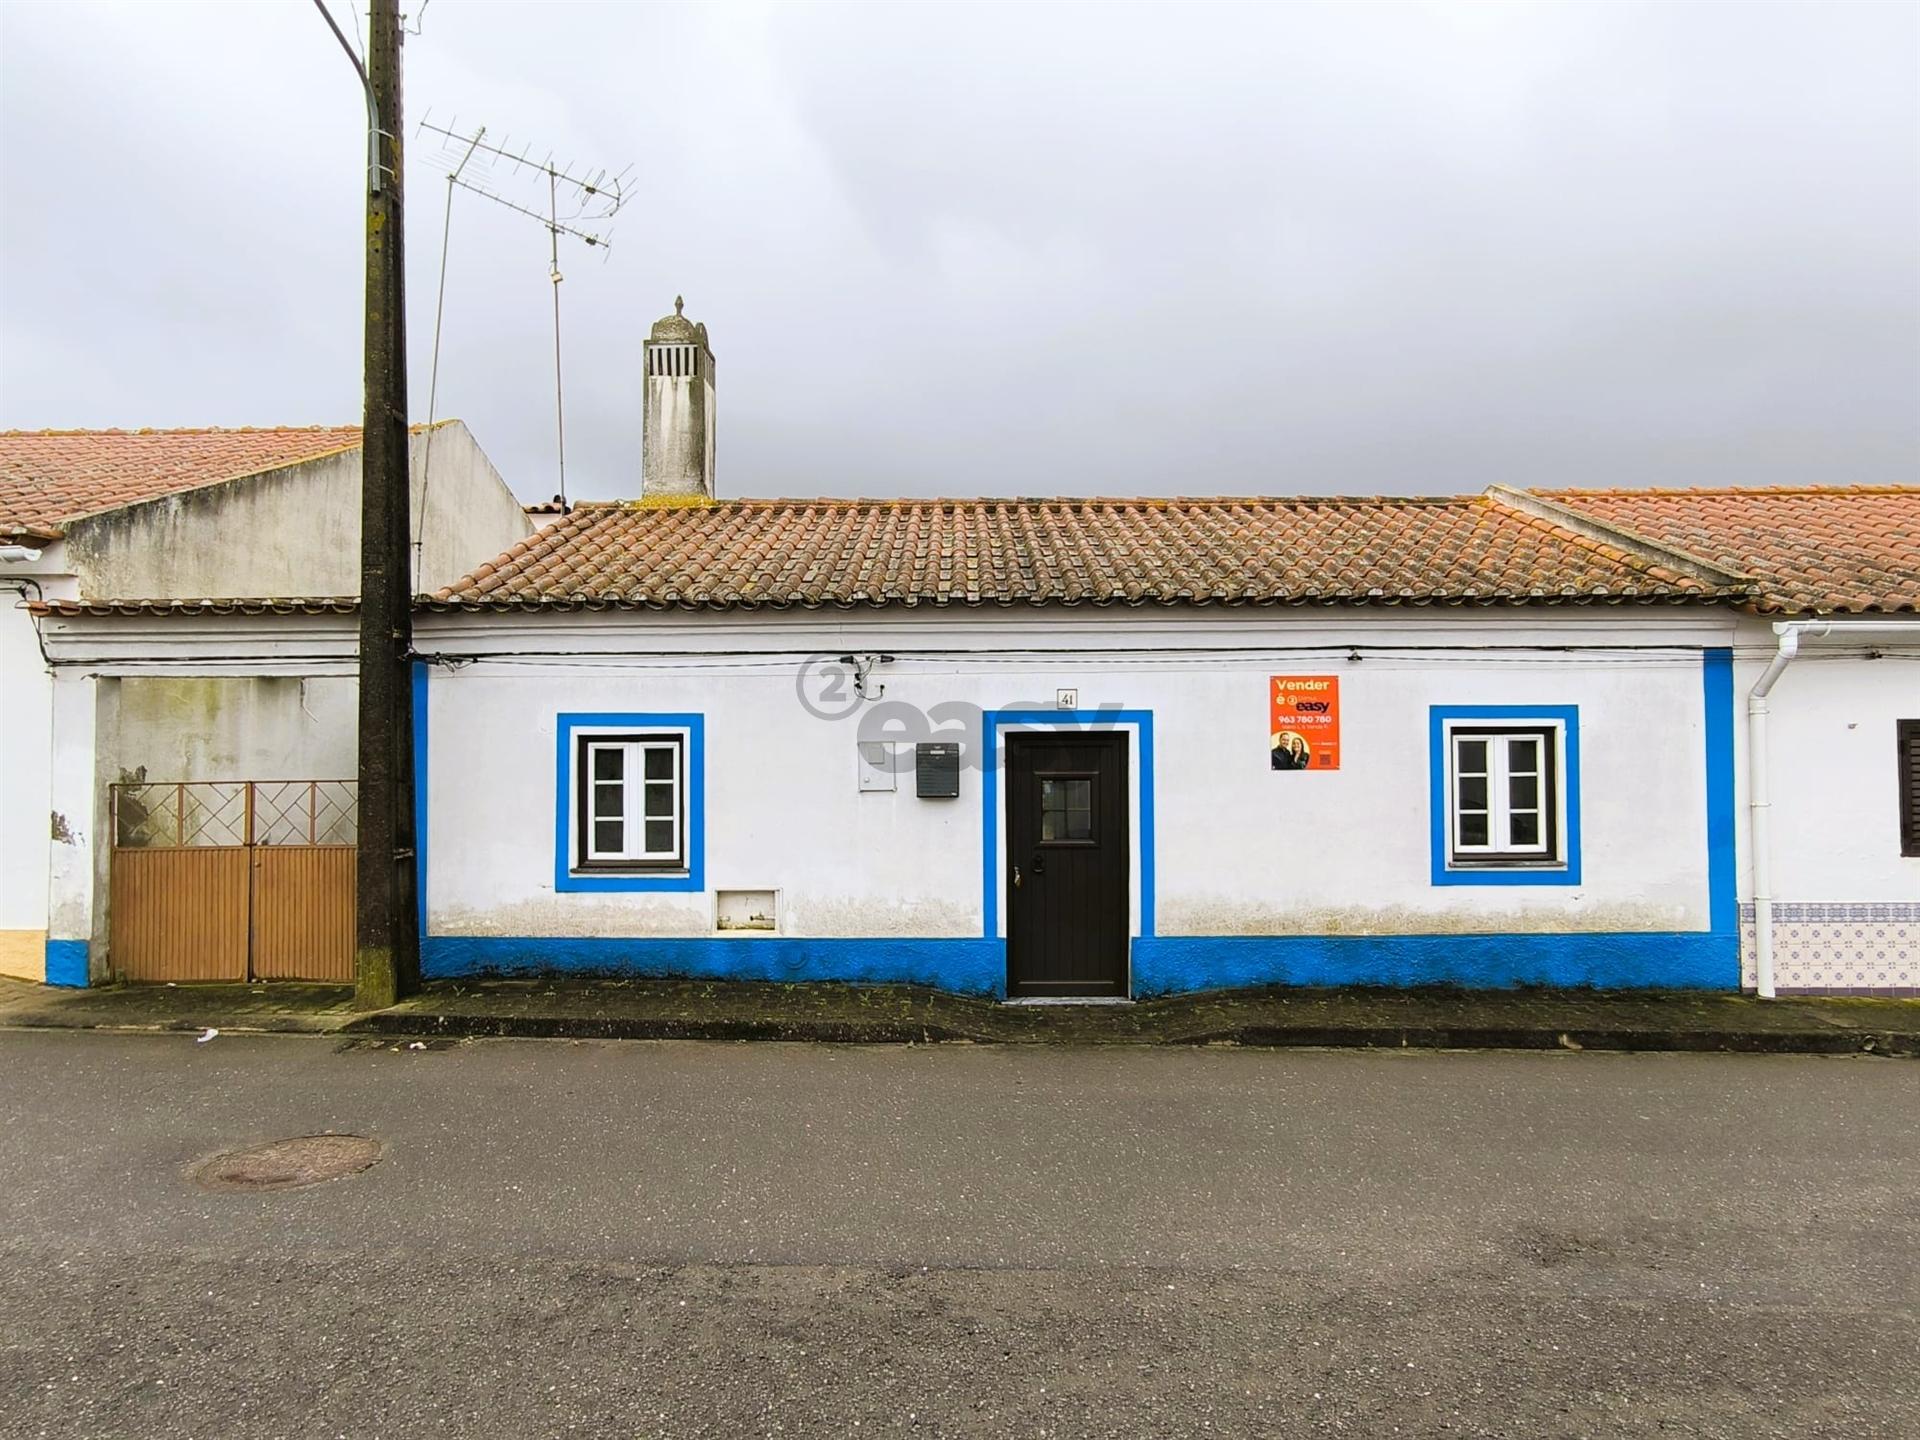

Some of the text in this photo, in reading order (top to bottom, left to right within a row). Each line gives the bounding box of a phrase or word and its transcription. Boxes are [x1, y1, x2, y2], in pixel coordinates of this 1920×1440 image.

[1276, 680, 1330, 690] Vender
[1061, 694, 1073, 705] 41
[1296, 702, 1330, 713] easy
[1278, 716, 1295, 724] 963
